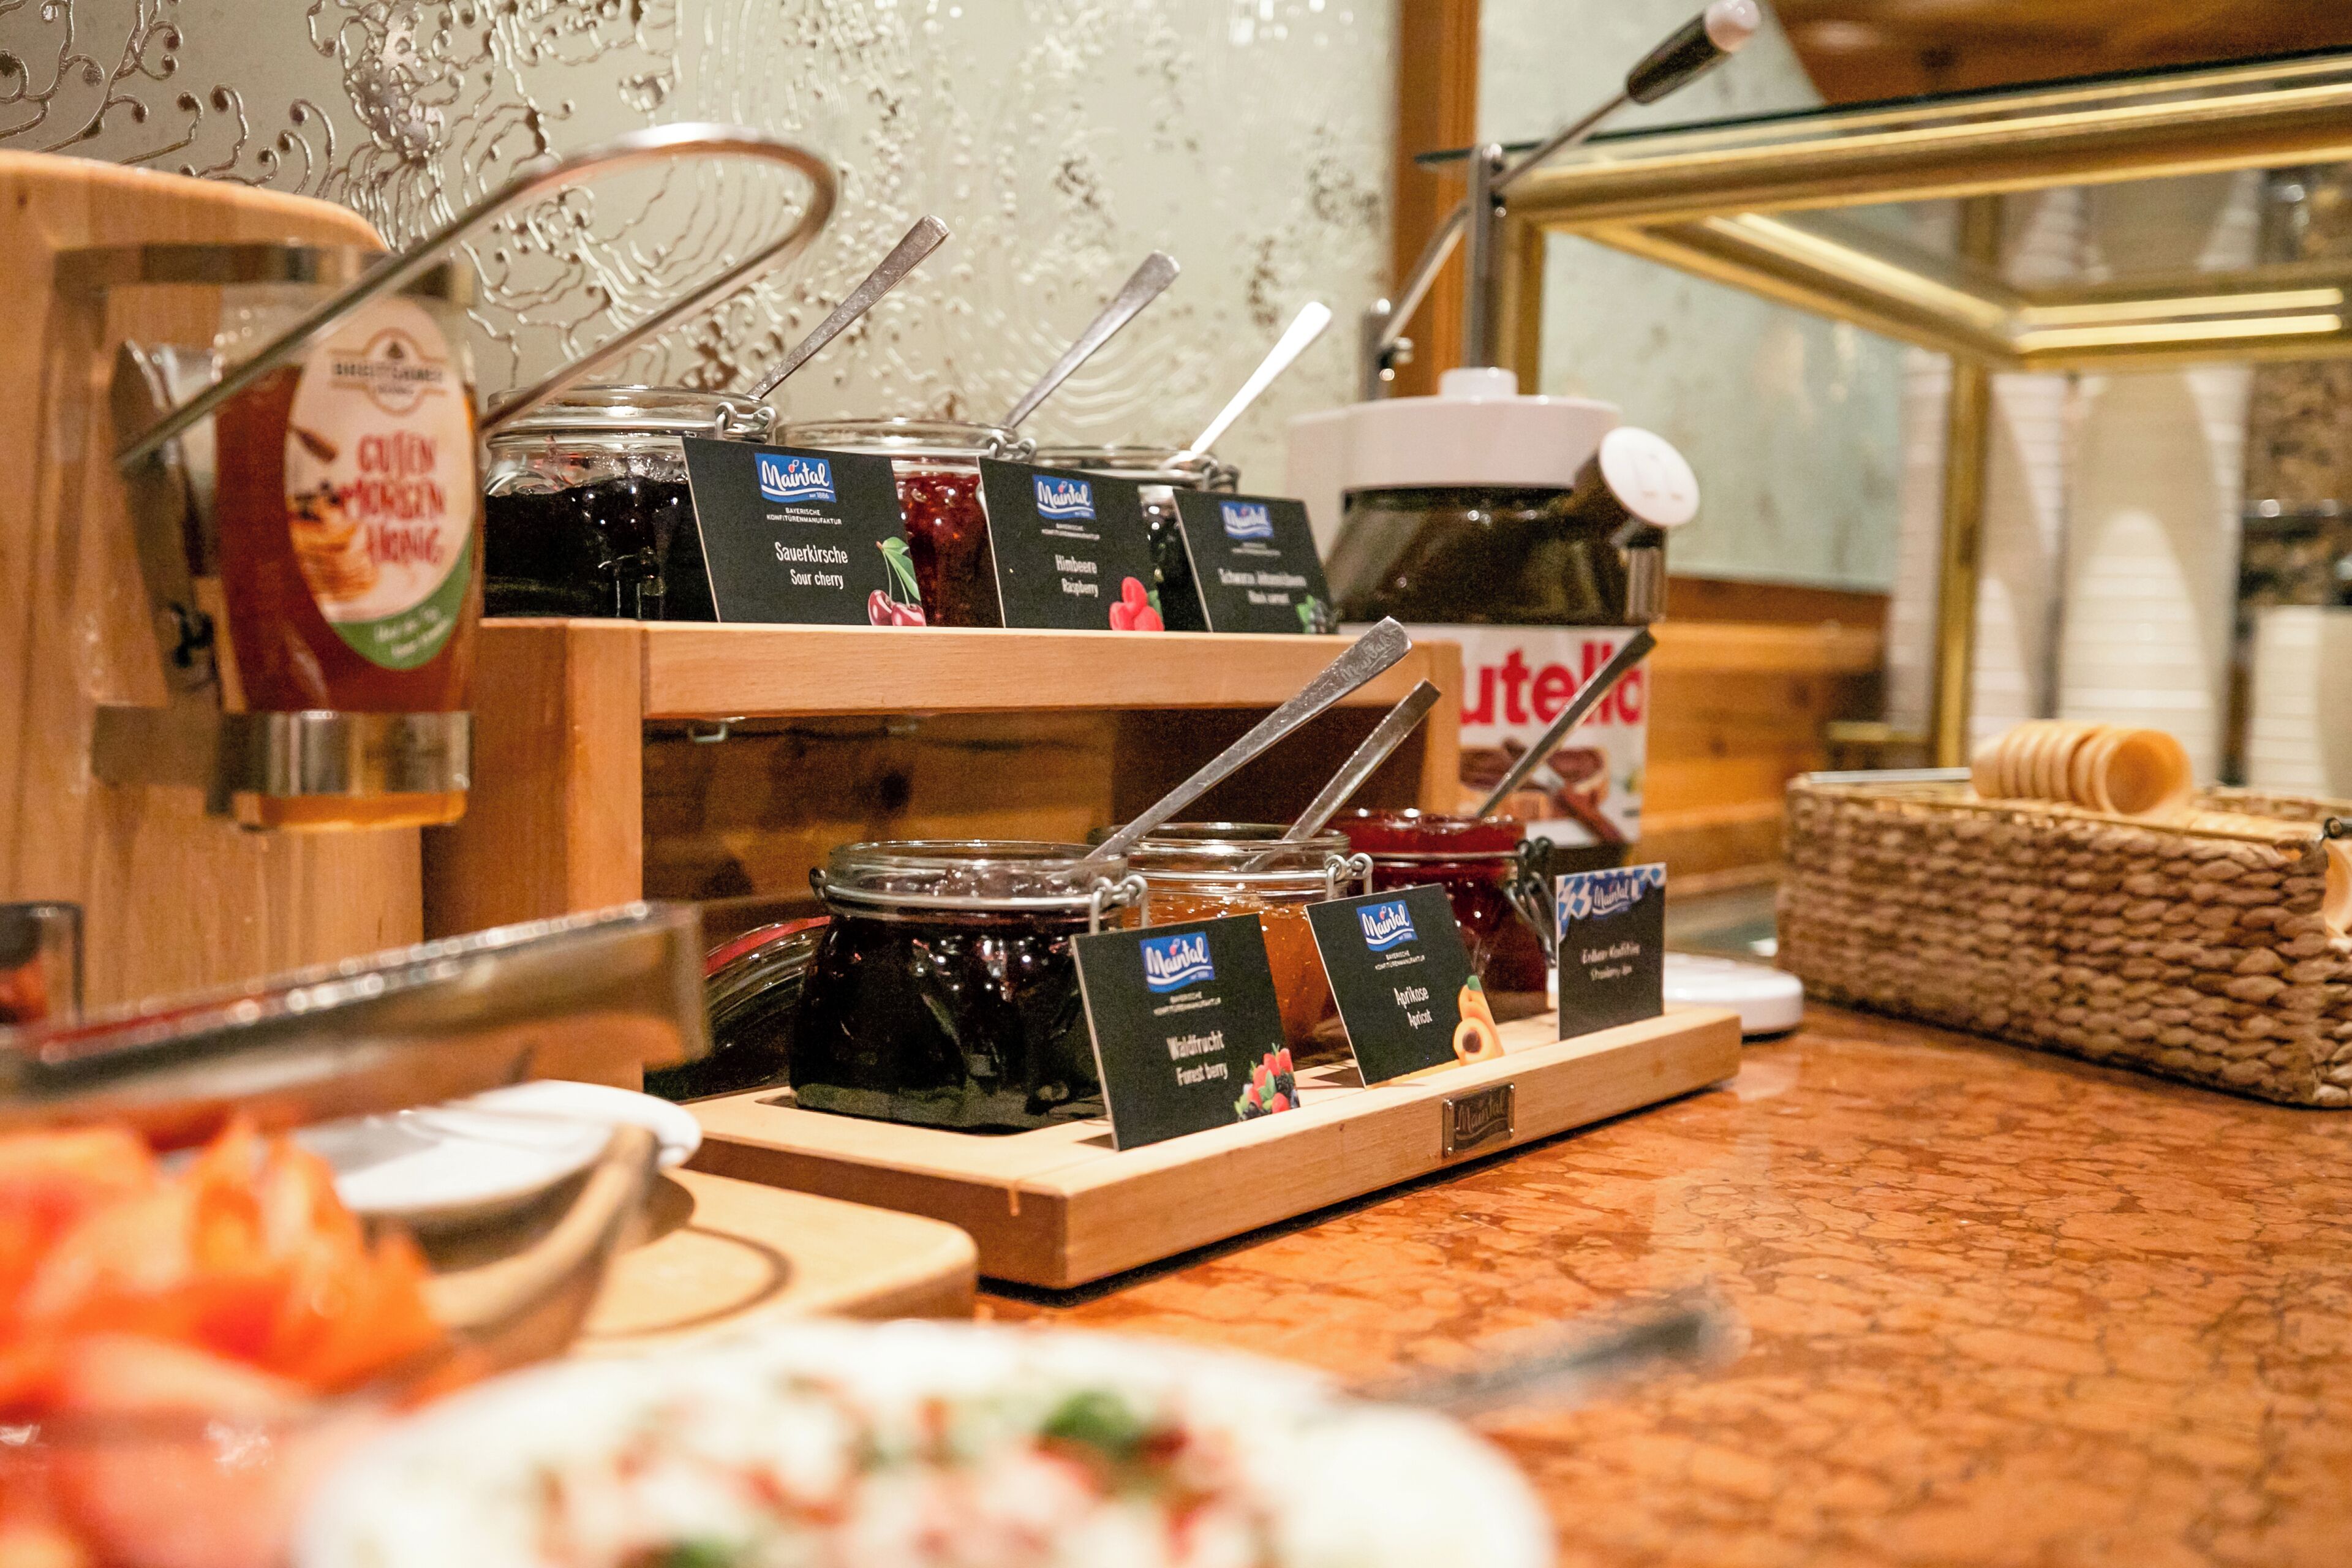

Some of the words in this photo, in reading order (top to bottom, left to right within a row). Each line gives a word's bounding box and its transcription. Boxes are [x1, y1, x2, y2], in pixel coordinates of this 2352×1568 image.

[761, 460, 829, 491] Maintal
[1038, 481, 1091, 508] Maintal
[766, 514, 842, 525] KONFITÜRENMANUFAKTUR
[785, 507, 821, 516] BAYERISCHE
[775, 541, 848, 564] Sauerkirsche
[1055, 554, 1097, 574] Himbeere
[790, 569, 812, 586] Sour
[814, 571, 844, 590] cherry
[1061, 578, 1099, 598] Raspberry
[1460, 641, 1643, 725] utella
[1362, 904, 1409, 939] Maintal
[1146, 937, 1208, 978] Maintal
[1393, 986, 1429, 1009] Aprikose
[1407, 1009, 1433, 1029] Apricot
[1166, 1030, 1224, 1061] Waldfrucht
[1176, 1065, 1205, 1086] Forest
[1205, 1063, 1228, 1080] berry
